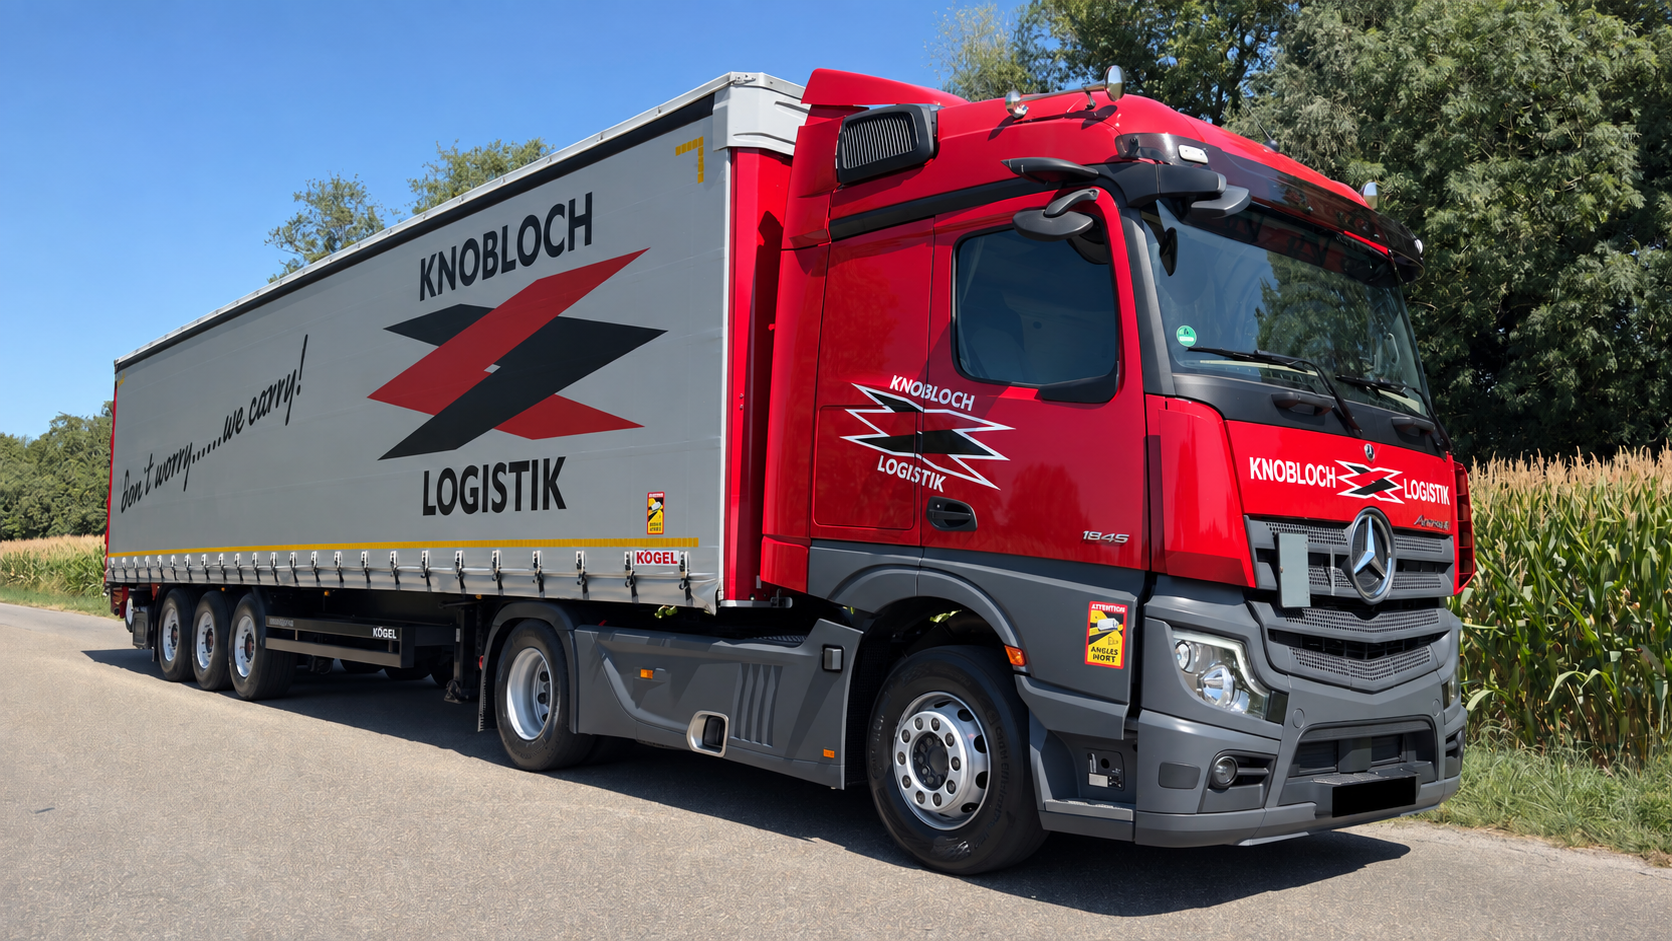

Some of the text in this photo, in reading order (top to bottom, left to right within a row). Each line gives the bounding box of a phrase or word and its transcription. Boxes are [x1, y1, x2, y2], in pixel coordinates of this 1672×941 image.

[419, 191, 593, 302] KNOBLOCH
[248, 333, 308, 426] carry!
[889, 375, 975, 411] KNOBLOCH
[422, 456, 567, 516] LOGISTIK
[877, 455, 946, 493] LOGISTIK
[1249, 457, 1450, 506] KNOBLOCH LOGISTIK
[1083, 530, 1129, 543] 1845
